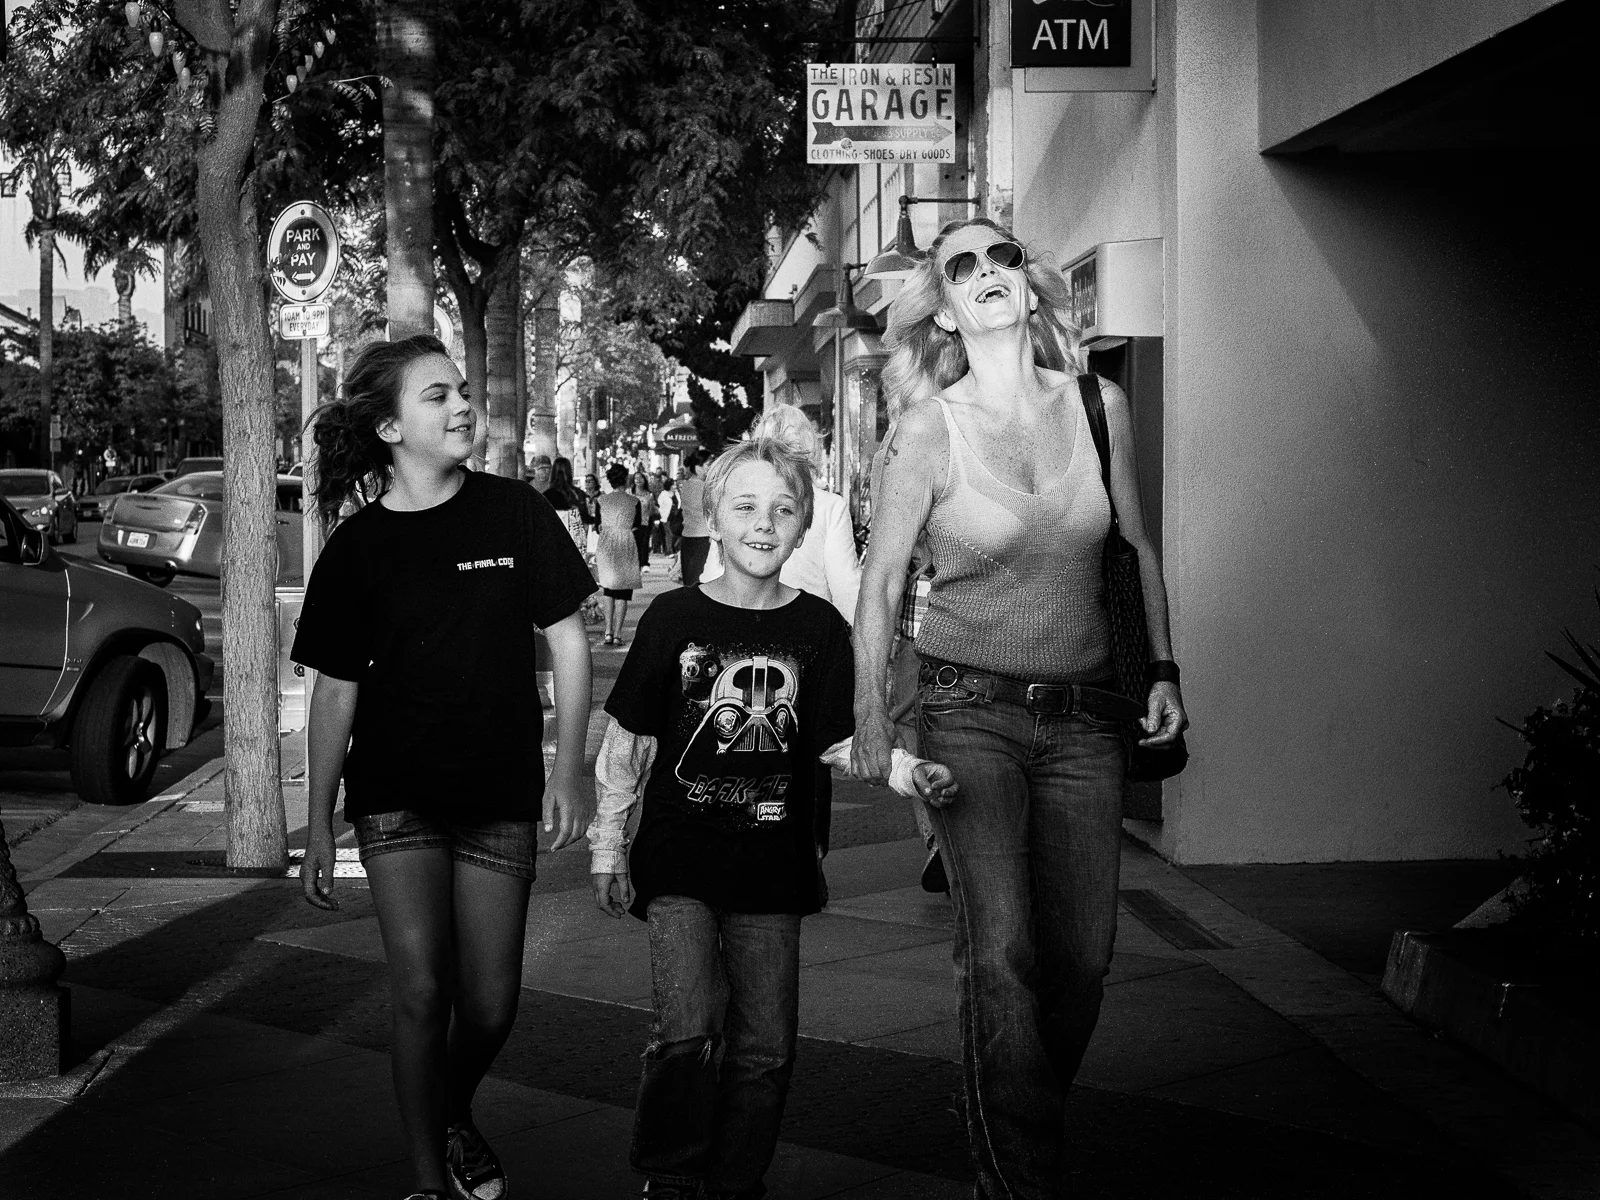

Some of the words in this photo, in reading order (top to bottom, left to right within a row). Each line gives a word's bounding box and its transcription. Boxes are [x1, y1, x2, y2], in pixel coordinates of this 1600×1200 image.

[1032, 18, 1109, 50] ATM
[811, 68, 837, 80] THE
[842, 68, 880, 85] IRON
[886, 68, 896, 86] &
[902, 68, 951, 85] RESIN
[812, 88, 952, 120] GARAGE
[895, 128, 928, 138] SUPPLY
[922, 149, 951, 160] GOODS
[286, 228, 320, 243] PARK
[296, 243, 311, 251] AND
[290, 252, 316, 266] PAY
[284, 312, 300, 322] 10AM
[302, 311, 310, 321] TO
[312, 310, 325, 320] 9PM
[289, 321, 320, 332] EVERYDAY
[457, 562, 472, 571] THE
[474, 559, 496, 569] FINAL
[760, 805, 781, 815] ANGRY
